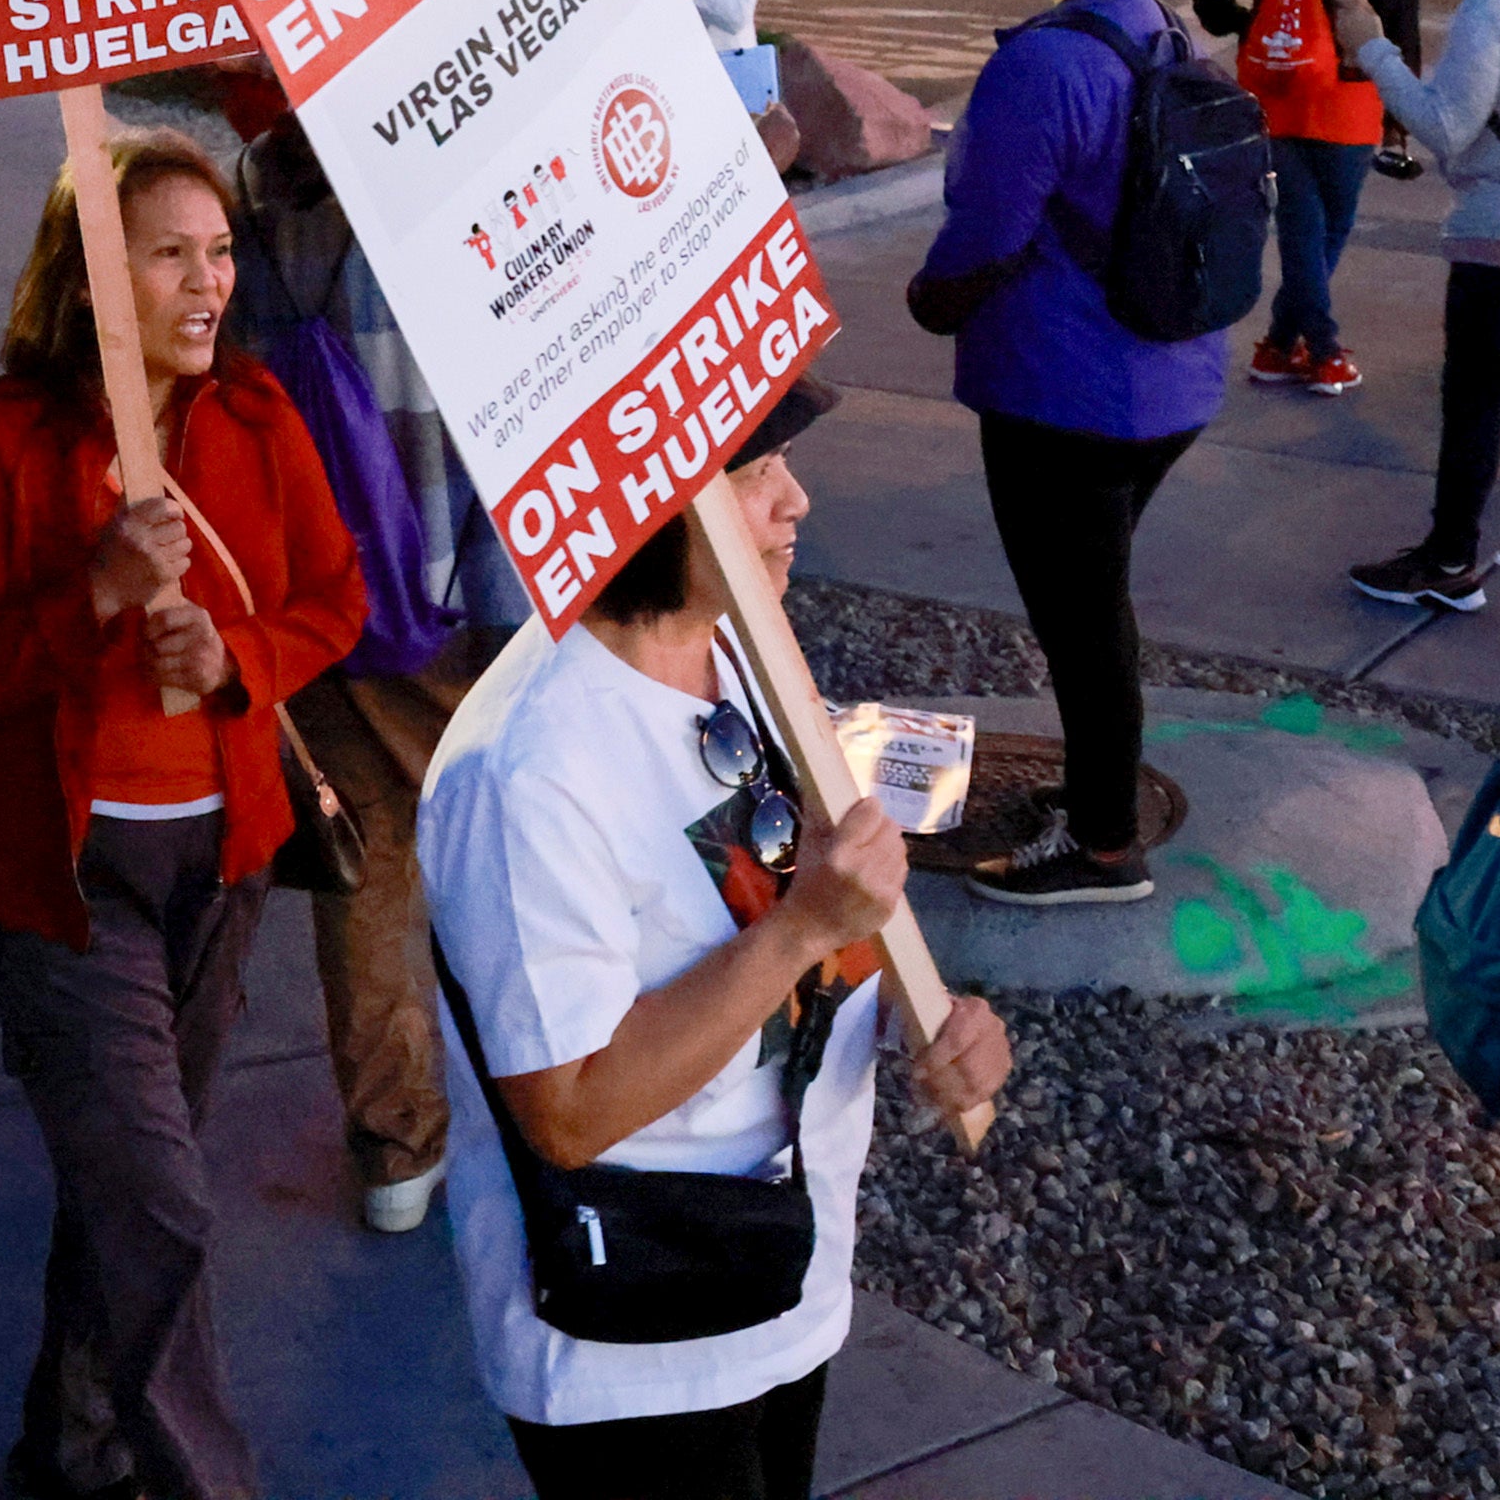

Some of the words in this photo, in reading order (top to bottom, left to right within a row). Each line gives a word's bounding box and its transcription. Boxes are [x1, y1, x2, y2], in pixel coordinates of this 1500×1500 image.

[3, 5, 250, 84] HUELGA
[372, 26, 495, 146] VIRGIN
[425, 73, 494, 147] LAS
[468, 403, 500, 439] We
[503, 375, 531, 411] are
[535, 335, 567, 376] not
[569, 275, 630, 343] asking
[629, 242, 657, 285] the
[658, 162, 735, 259] employees
[735, 141, 751, 173] of
[489, 258, 553, 322] WORKERS
[552, 218, 595, 264] UNION
[504, 219, 565, 281] CULINARY
[493, 413, 526, 449] any
[528, 361, 576, 411] other
[578, 282, 661, 367] employer
[660, 254, 678, 285] to
[677, 220, 712, 269] stop
[709, 185, 751, 231] work.
[508, 438, 601, 558] ON
[607, 218, 808, 455] STRIKE
[534, 513, 618, 619] EN
[619, 286, 830, 525] HUELGA
